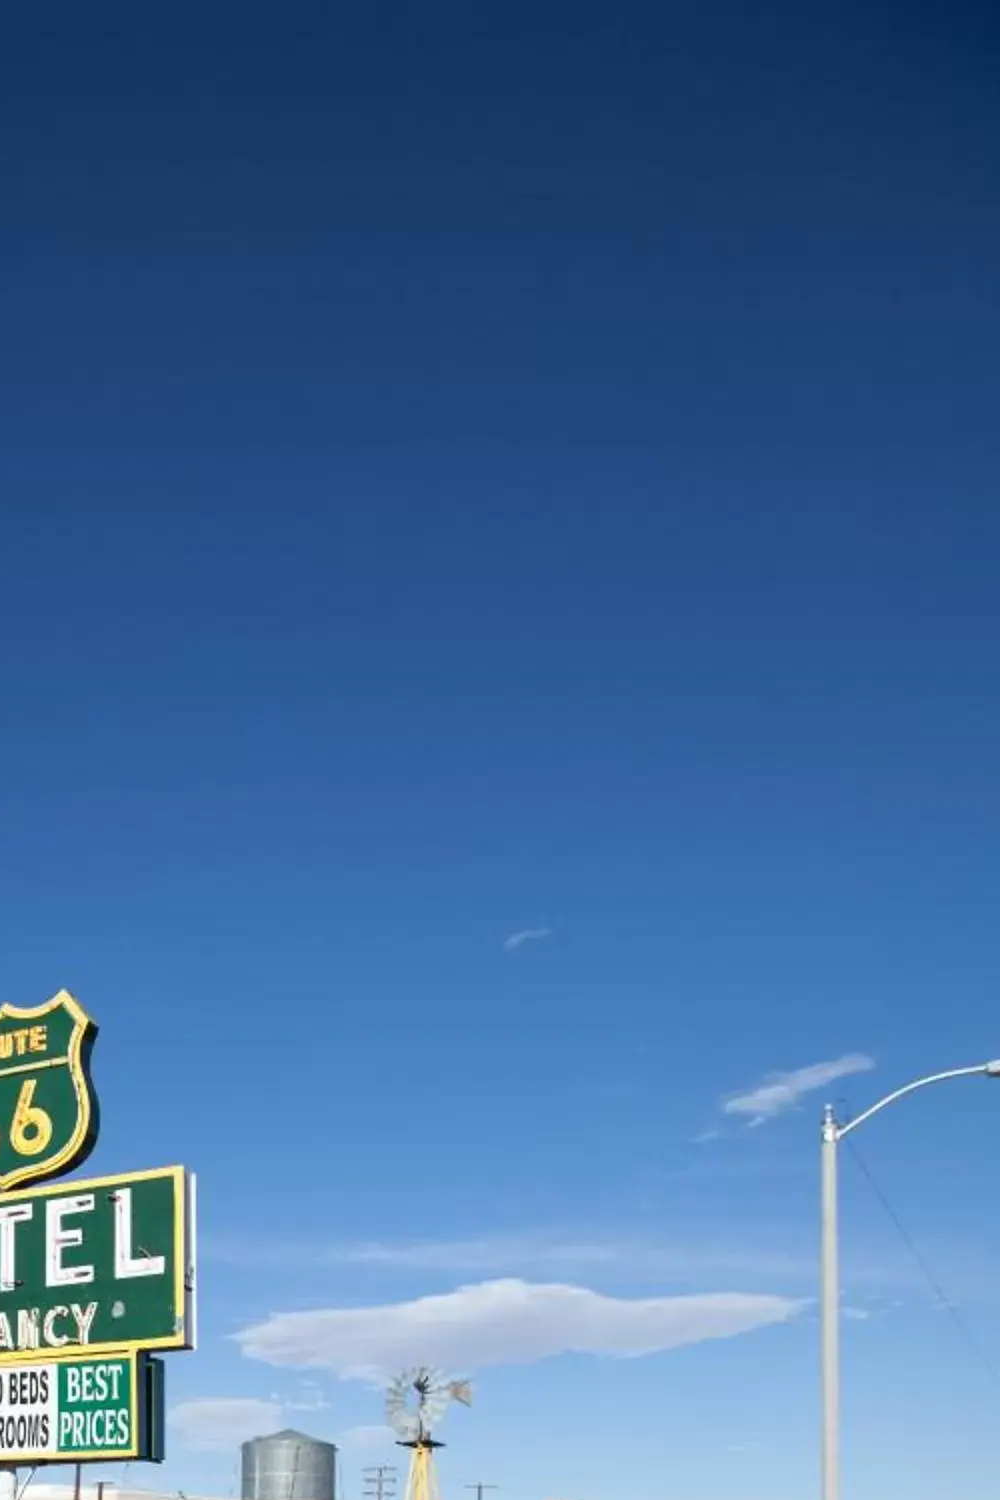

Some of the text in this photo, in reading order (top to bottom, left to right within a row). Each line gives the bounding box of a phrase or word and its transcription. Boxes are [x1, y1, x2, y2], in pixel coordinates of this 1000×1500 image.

[9, 1370, 49, 1405] BEDS
[66, 1364, 122, 1403] BEST
[60, 1410, 129, 1447] PRICES
